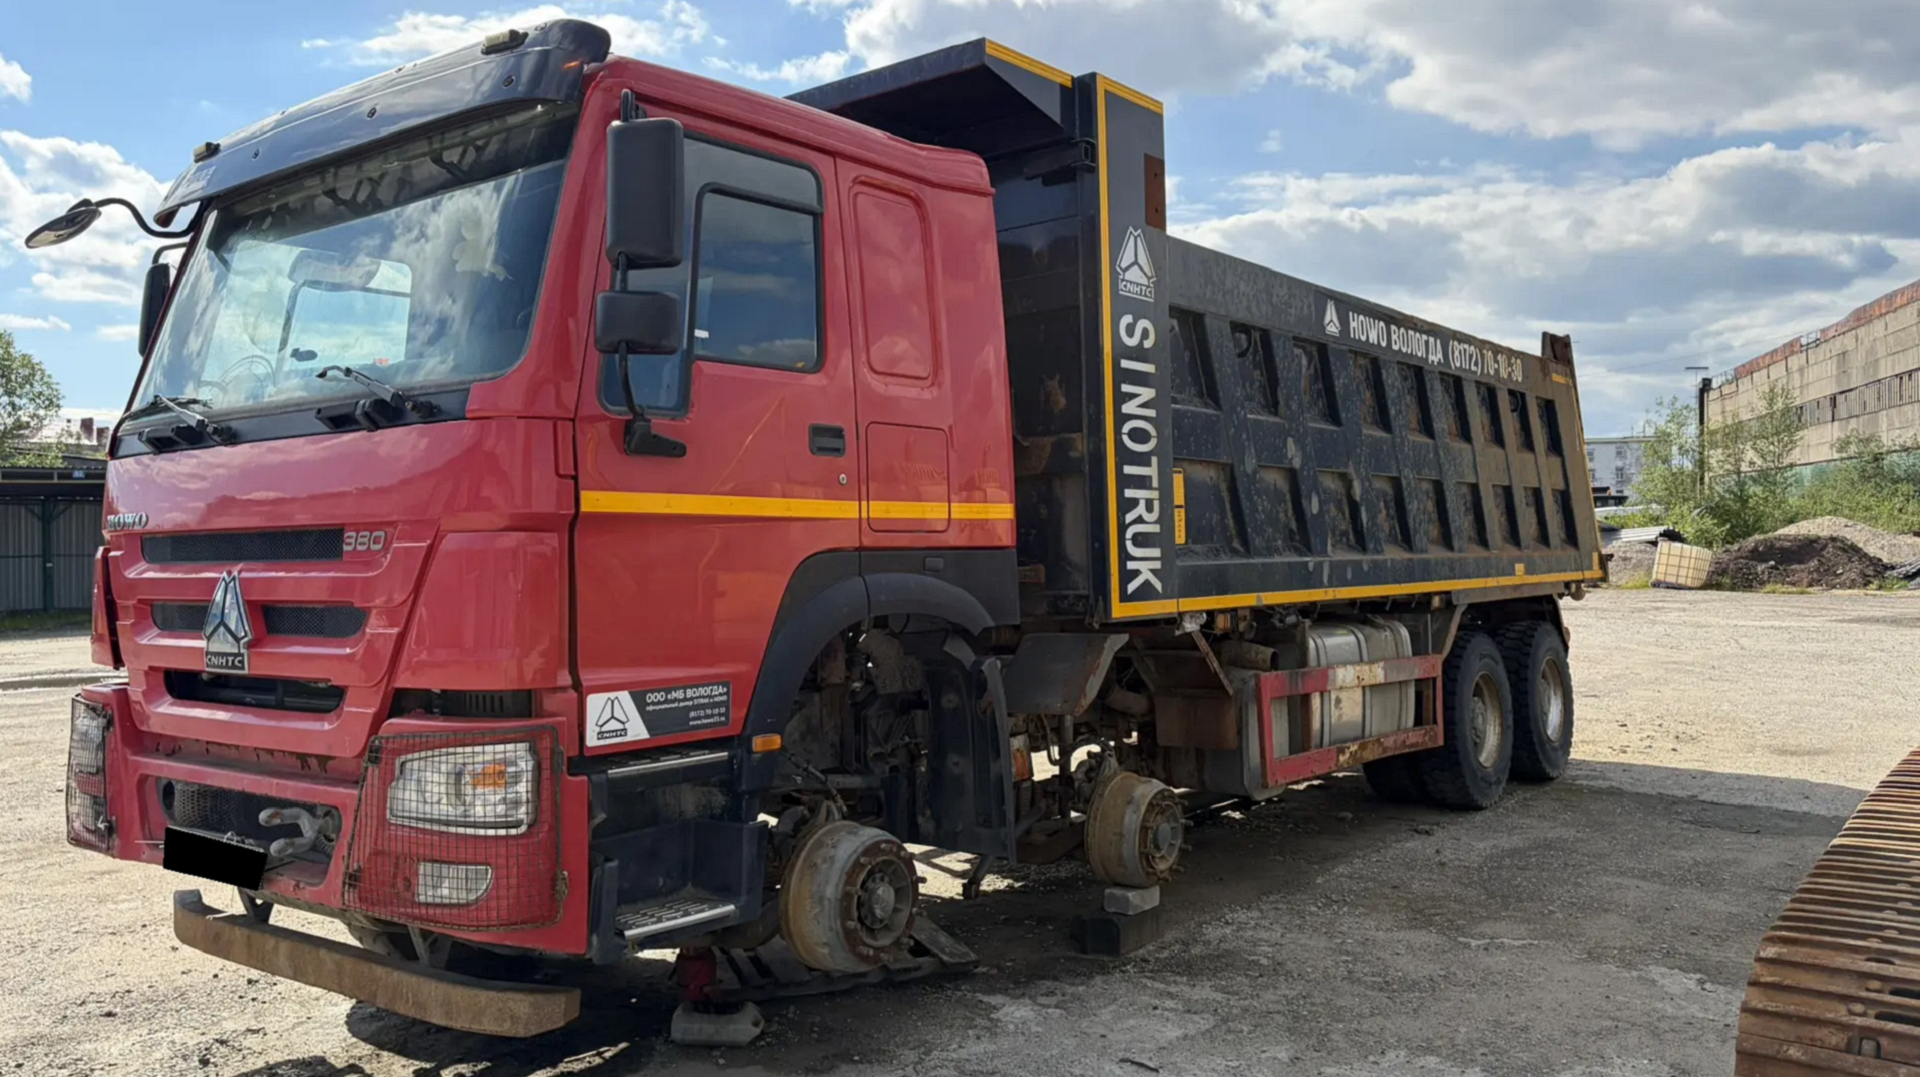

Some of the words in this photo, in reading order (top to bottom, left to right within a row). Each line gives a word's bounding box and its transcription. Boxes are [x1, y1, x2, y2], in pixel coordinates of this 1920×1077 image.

[1120, 281, 1152, 298] CNHTC
[1349, 311, 1387, 348] HOWO
[1390, 324, 1444, 366] ВОЛОГДА
[1449, 339, 1482, 376] (8172)
[1119, 313, 1162, 595] SINOTRUK
[343, 531, 385, 551] 380
[206, 655, 243, 667] CNHTC
[646, 692, 665, 703] ООО
[667, 689, 685, 700] «МБ
[686, 685, 727, 699] ВОЛОГДА»
[598, 730, 626, 739] CNHTC
